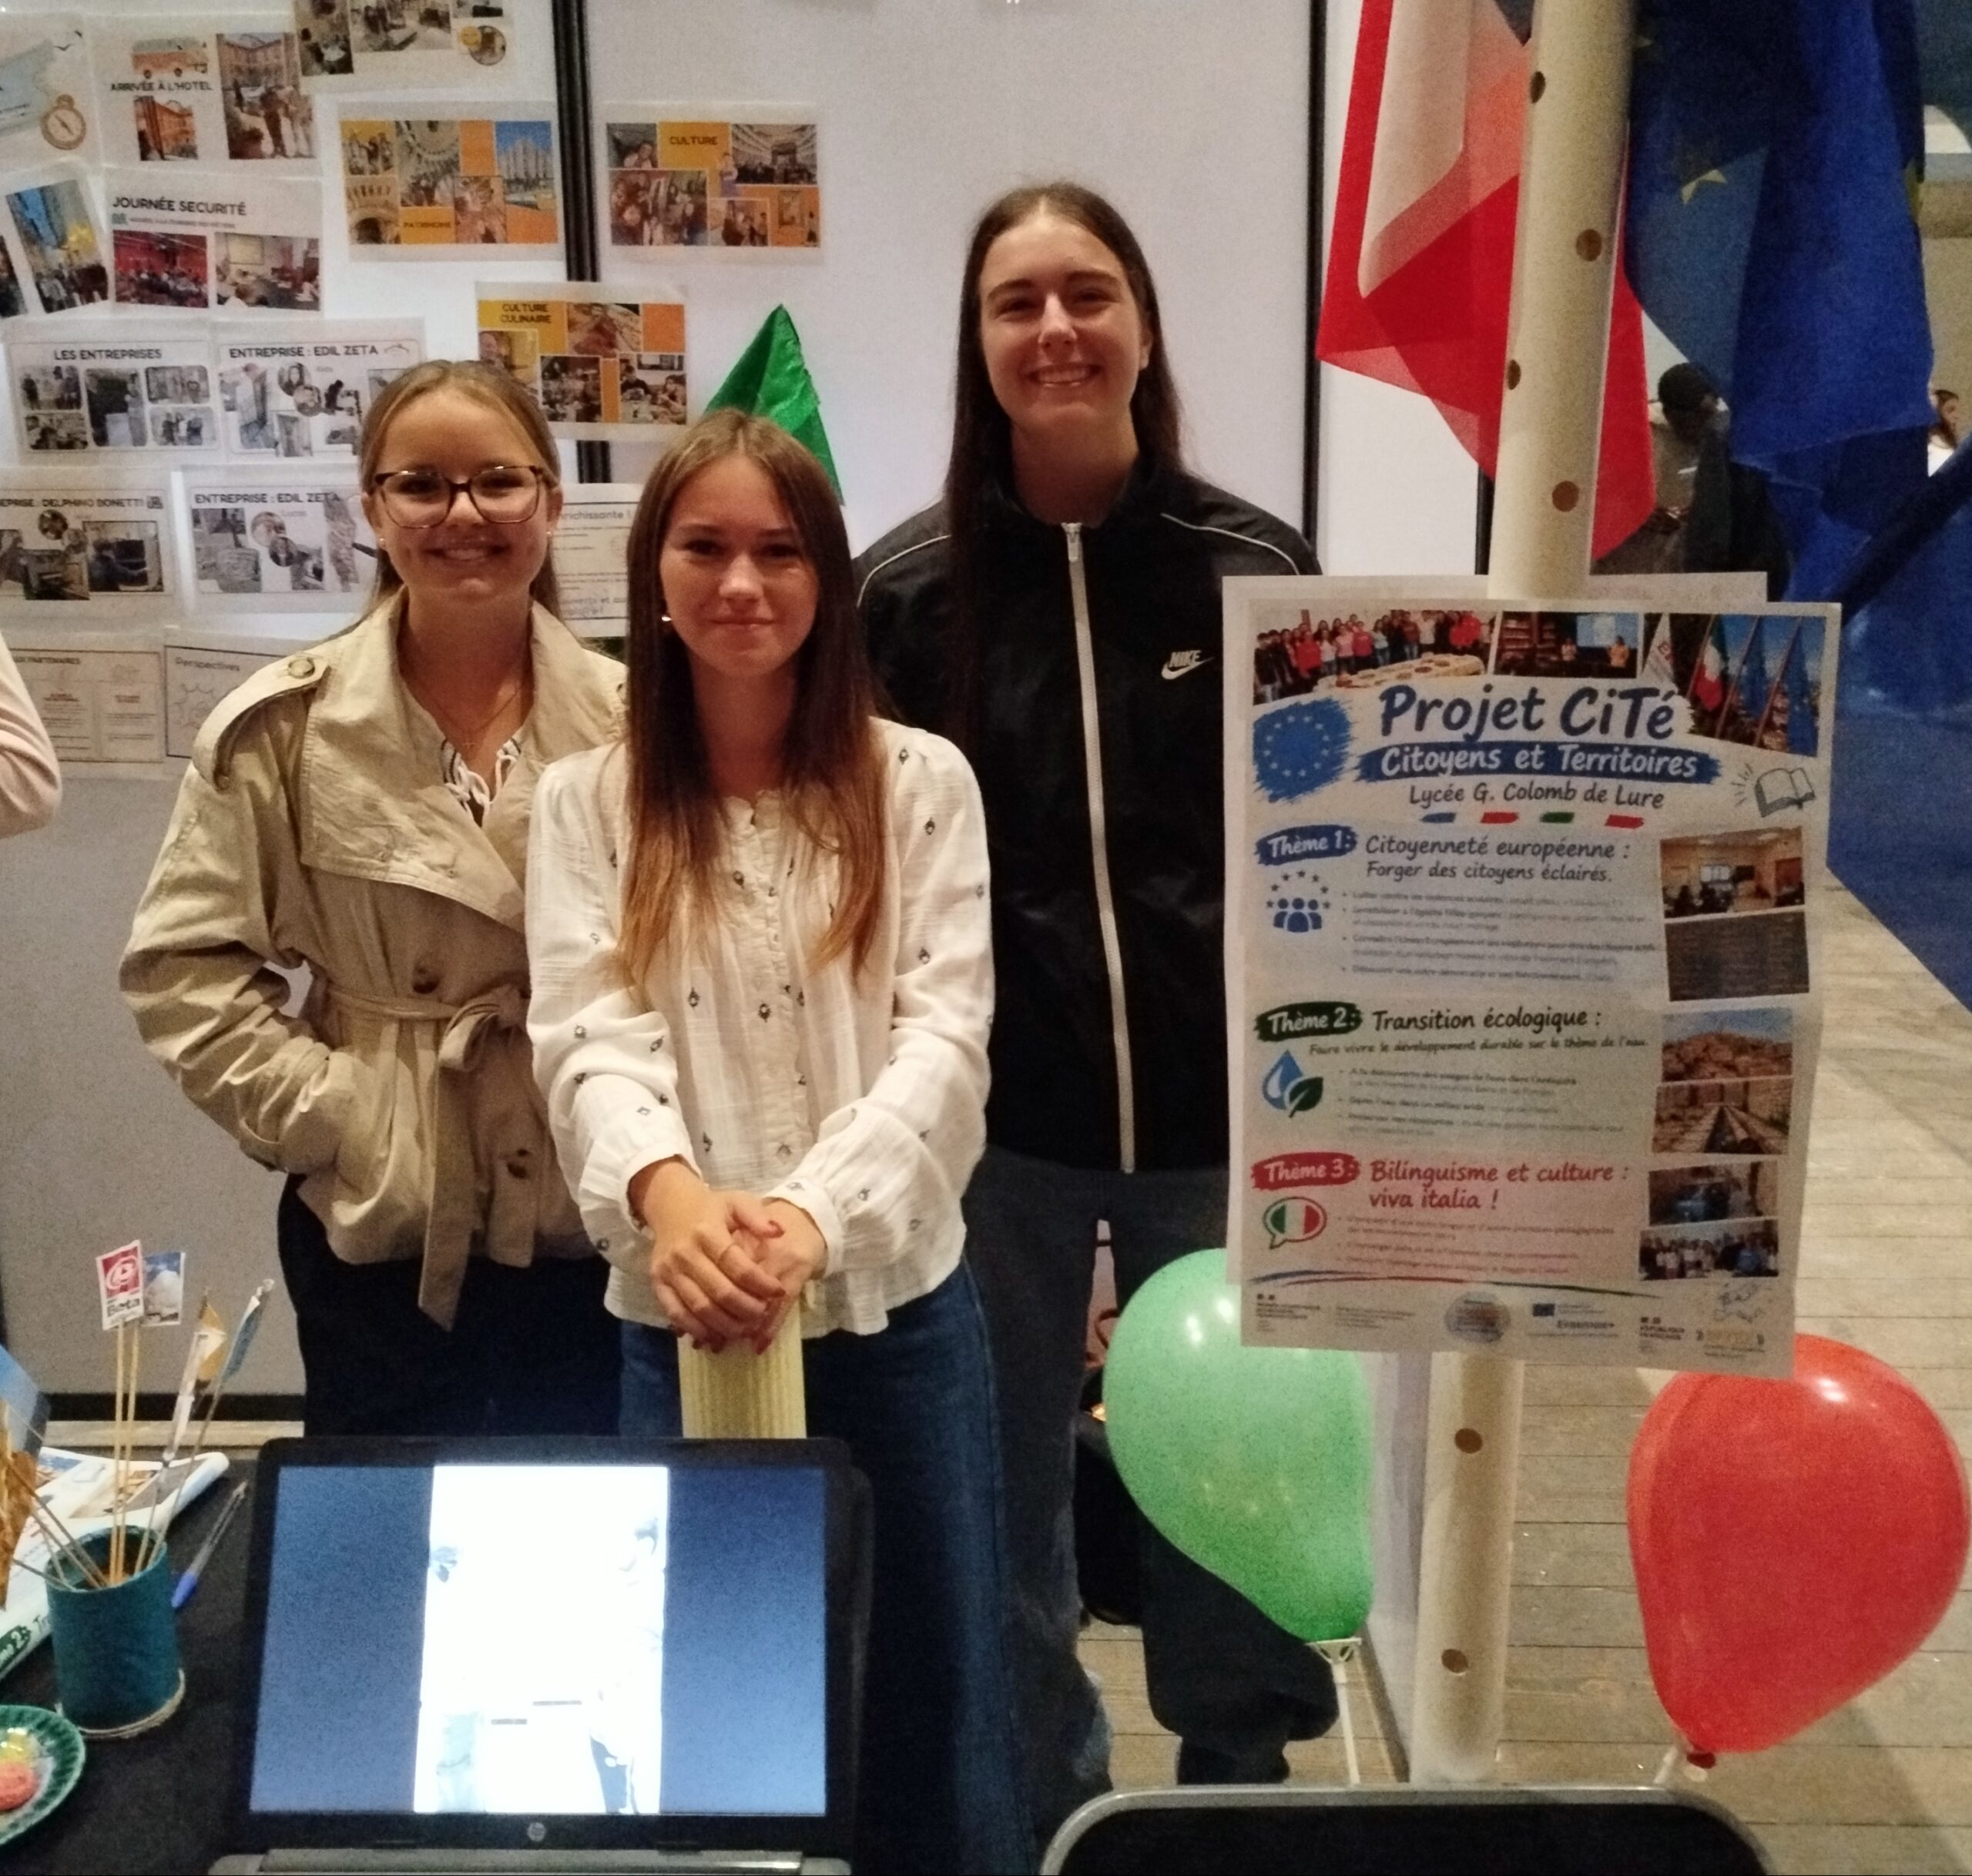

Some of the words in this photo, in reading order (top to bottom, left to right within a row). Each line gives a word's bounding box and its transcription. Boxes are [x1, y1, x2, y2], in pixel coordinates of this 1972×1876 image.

[669, 136, 718, 146] CULTURE
[113, 196, 176, 212] JOURNÉE
[179, 201, 247, 216] SECURITÉ
[502, 303, 548, 313] CULTURE
[55, 350, 76, 360] LES
[79, 349, 163, 360] ENTREPRISES
[230, 347, 305, 359] ENTREPRISE
[314, 347, 341, 357] EDIL
[344, 345, 378, 356] ZETA
[194, 494, 268, 504] ENTREPRISE
[277, 493, 304, 503] EDIL
[306, 493, 340, 503] ZETA
[1169, 650, 1202, 668] NIKE
[1379, 683, 1546, 742] Projet
[1559, 685, 1675, 740] CiTé
[1381, 745, 1501, 777] Citoyens
[1514, 744, 1545, 770] et
[1558, 743, 1699, 779] Territoires
[1409, 784, 1465, 809] Lycée
[1473, 782, 1494, 803] G.
[1503, 780, 1578, 802] Colomb
[1583, 782, 1608, 803] de
[1615, 785, 1665, 809] Lure
[1268, 835, 1330, 858] Thème
[1334, 830, 1351, 850] 1:
[1365, 834, 1488, 861] Citoyenneté
[1496, 836, 1615, 863] européenne
[1622, 844, 1631, 859] :
[1367, 860, 1424, 883] Forger
[1428, 860, 1457, 879] des
[1464, 861, 1534, 884] citoyens
[1541, 863, 1612, 882] éclairés.
[1267, 1010, 1329, 1035] Thème
[1333, 1007, 1356, 1028] 2:
[1372, 1008, 1475, 1031] Transition
[1483, 1005, 1588, 1034] écologique
[1595, 1011, 1602, 1027] :
[1264, 1161, 1327, 1183] Thème
[1330, 1157, 1354, 1178] 3:
[1370, 1159, 1499, 1188] Bilinguisme
[1506, 1162, 1531, 1182] et
[1536, 1161, 1615, 1182] culture
[1622, 1166, 1630, 1181] :
[1369, 1188, 1414, 1208] viva
[1420, 1187, 1481, 1209] italia
[1491, 1188, 1499, 1211] !
